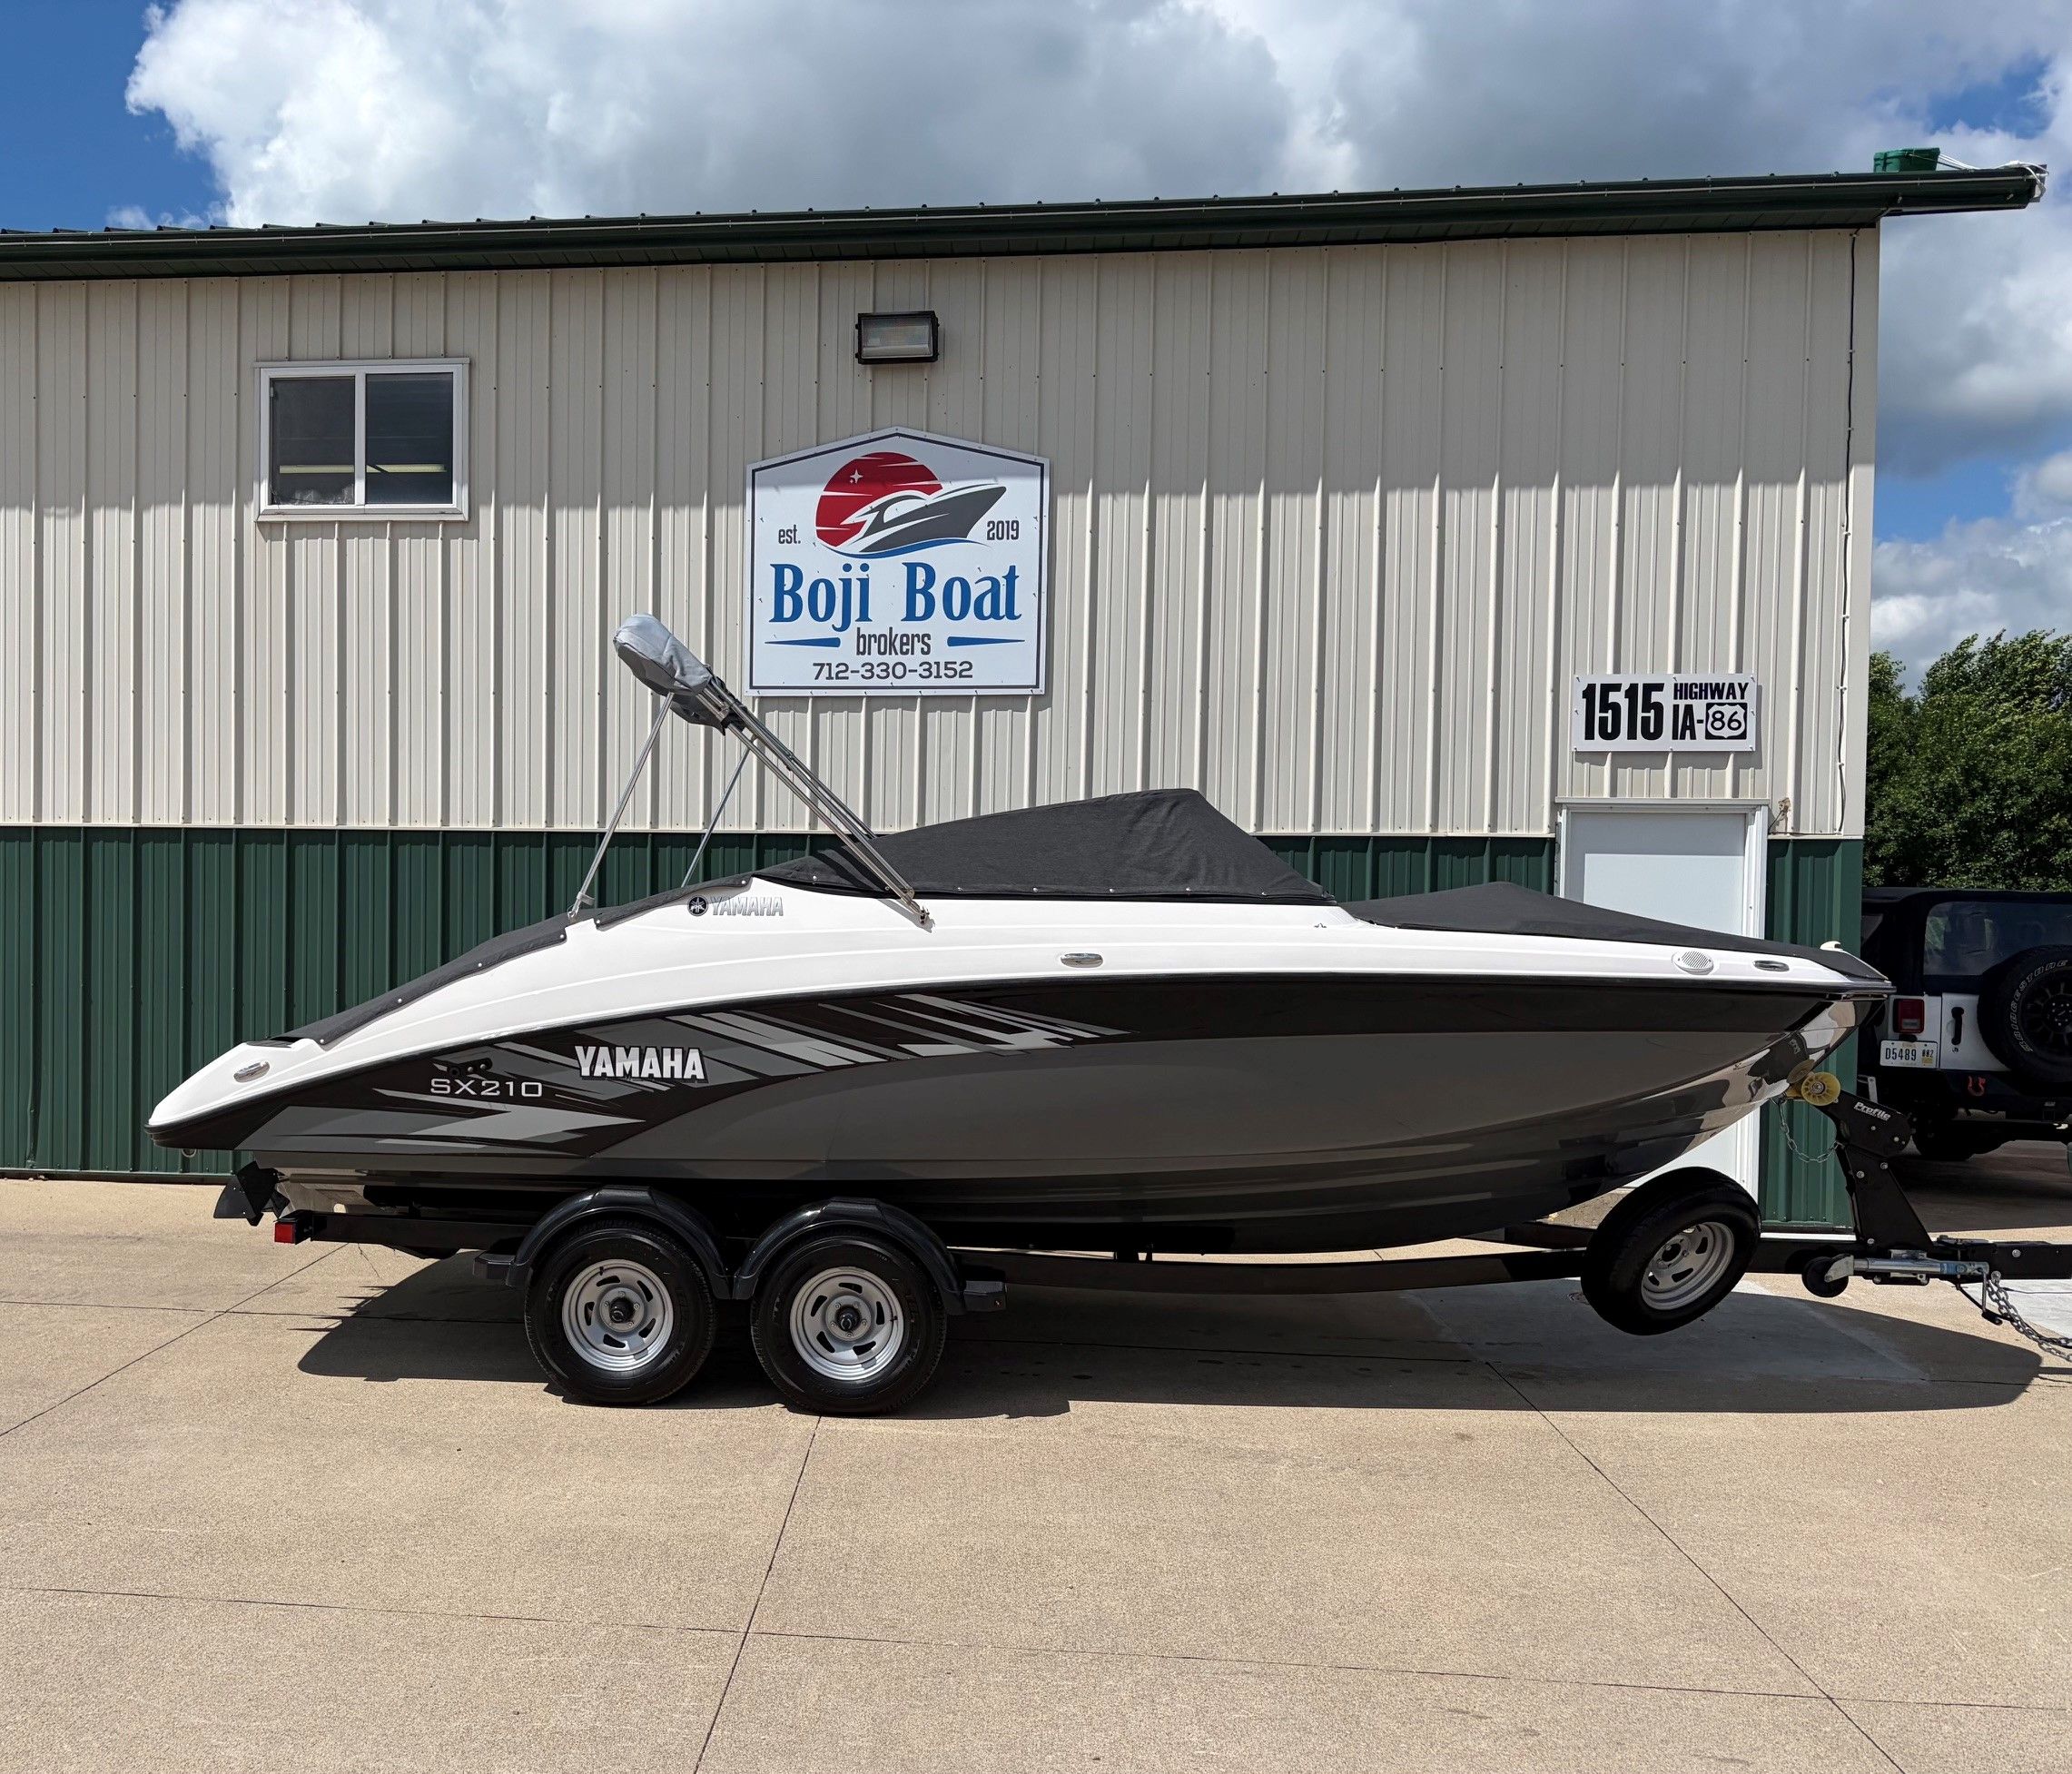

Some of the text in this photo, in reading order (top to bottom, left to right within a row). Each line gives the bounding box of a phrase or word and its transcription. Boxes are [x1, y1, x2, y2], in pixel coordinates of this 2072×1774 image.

[778, 519, 1020, 544] est. 2019
[769, 561, 1022, 633] Boji Boat
[855, 626, 932, 656] brokers
[813, 660, 973, 681] 712-330-3152
[1672, 682, 1750, 700] HIGHWAY
[1582, 683, 1665, 741] 1515
[711, 896, 784, 917] YAMAHA
[574, 1045, 706, 1081] YAMAHA
[1885, 1048, 1917, 1061] D5489
[430, 1079, 543, 1098] SX210
